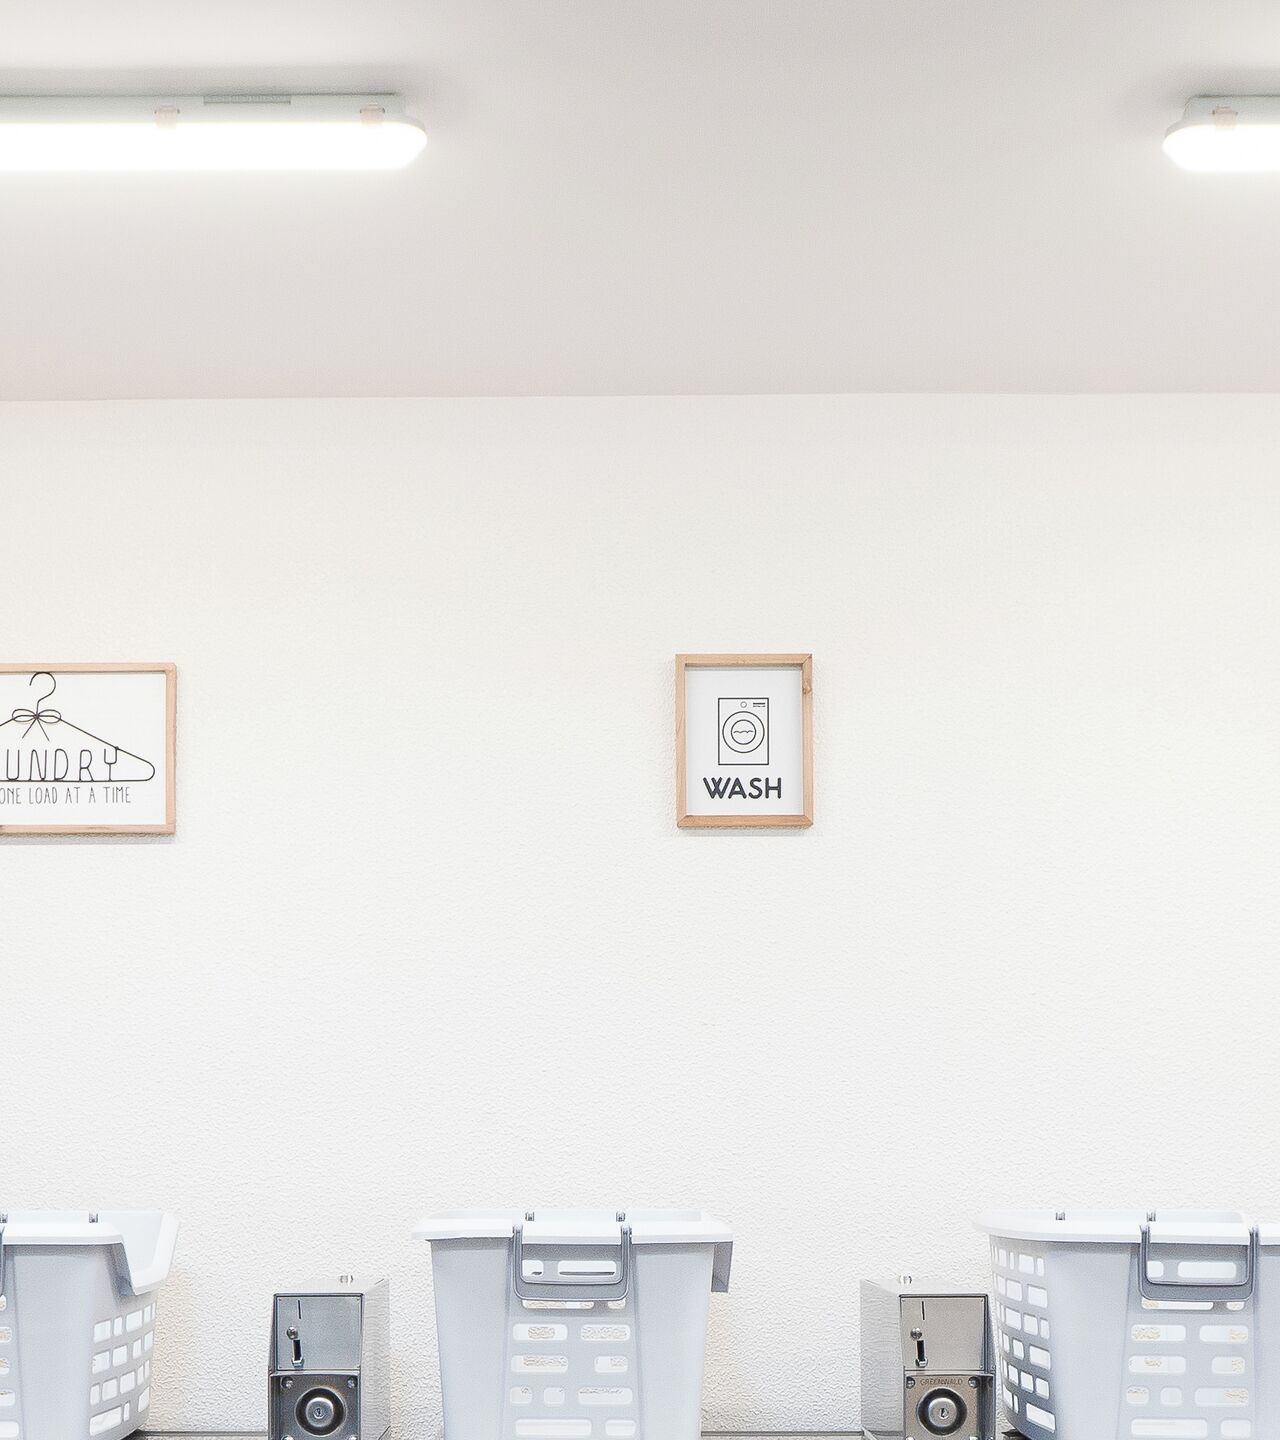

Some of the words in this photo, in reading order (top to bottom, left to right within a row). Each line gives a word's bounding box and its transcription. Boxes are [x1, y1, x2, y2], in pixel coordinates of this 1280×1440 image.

[29, 787, 58, 805] LOAD
[65, 786, 81, 804] AT
[89, 786, 96, 804] A
[103, 786, 131, 804] TIME
[703, 777, 782, 799] WASH
